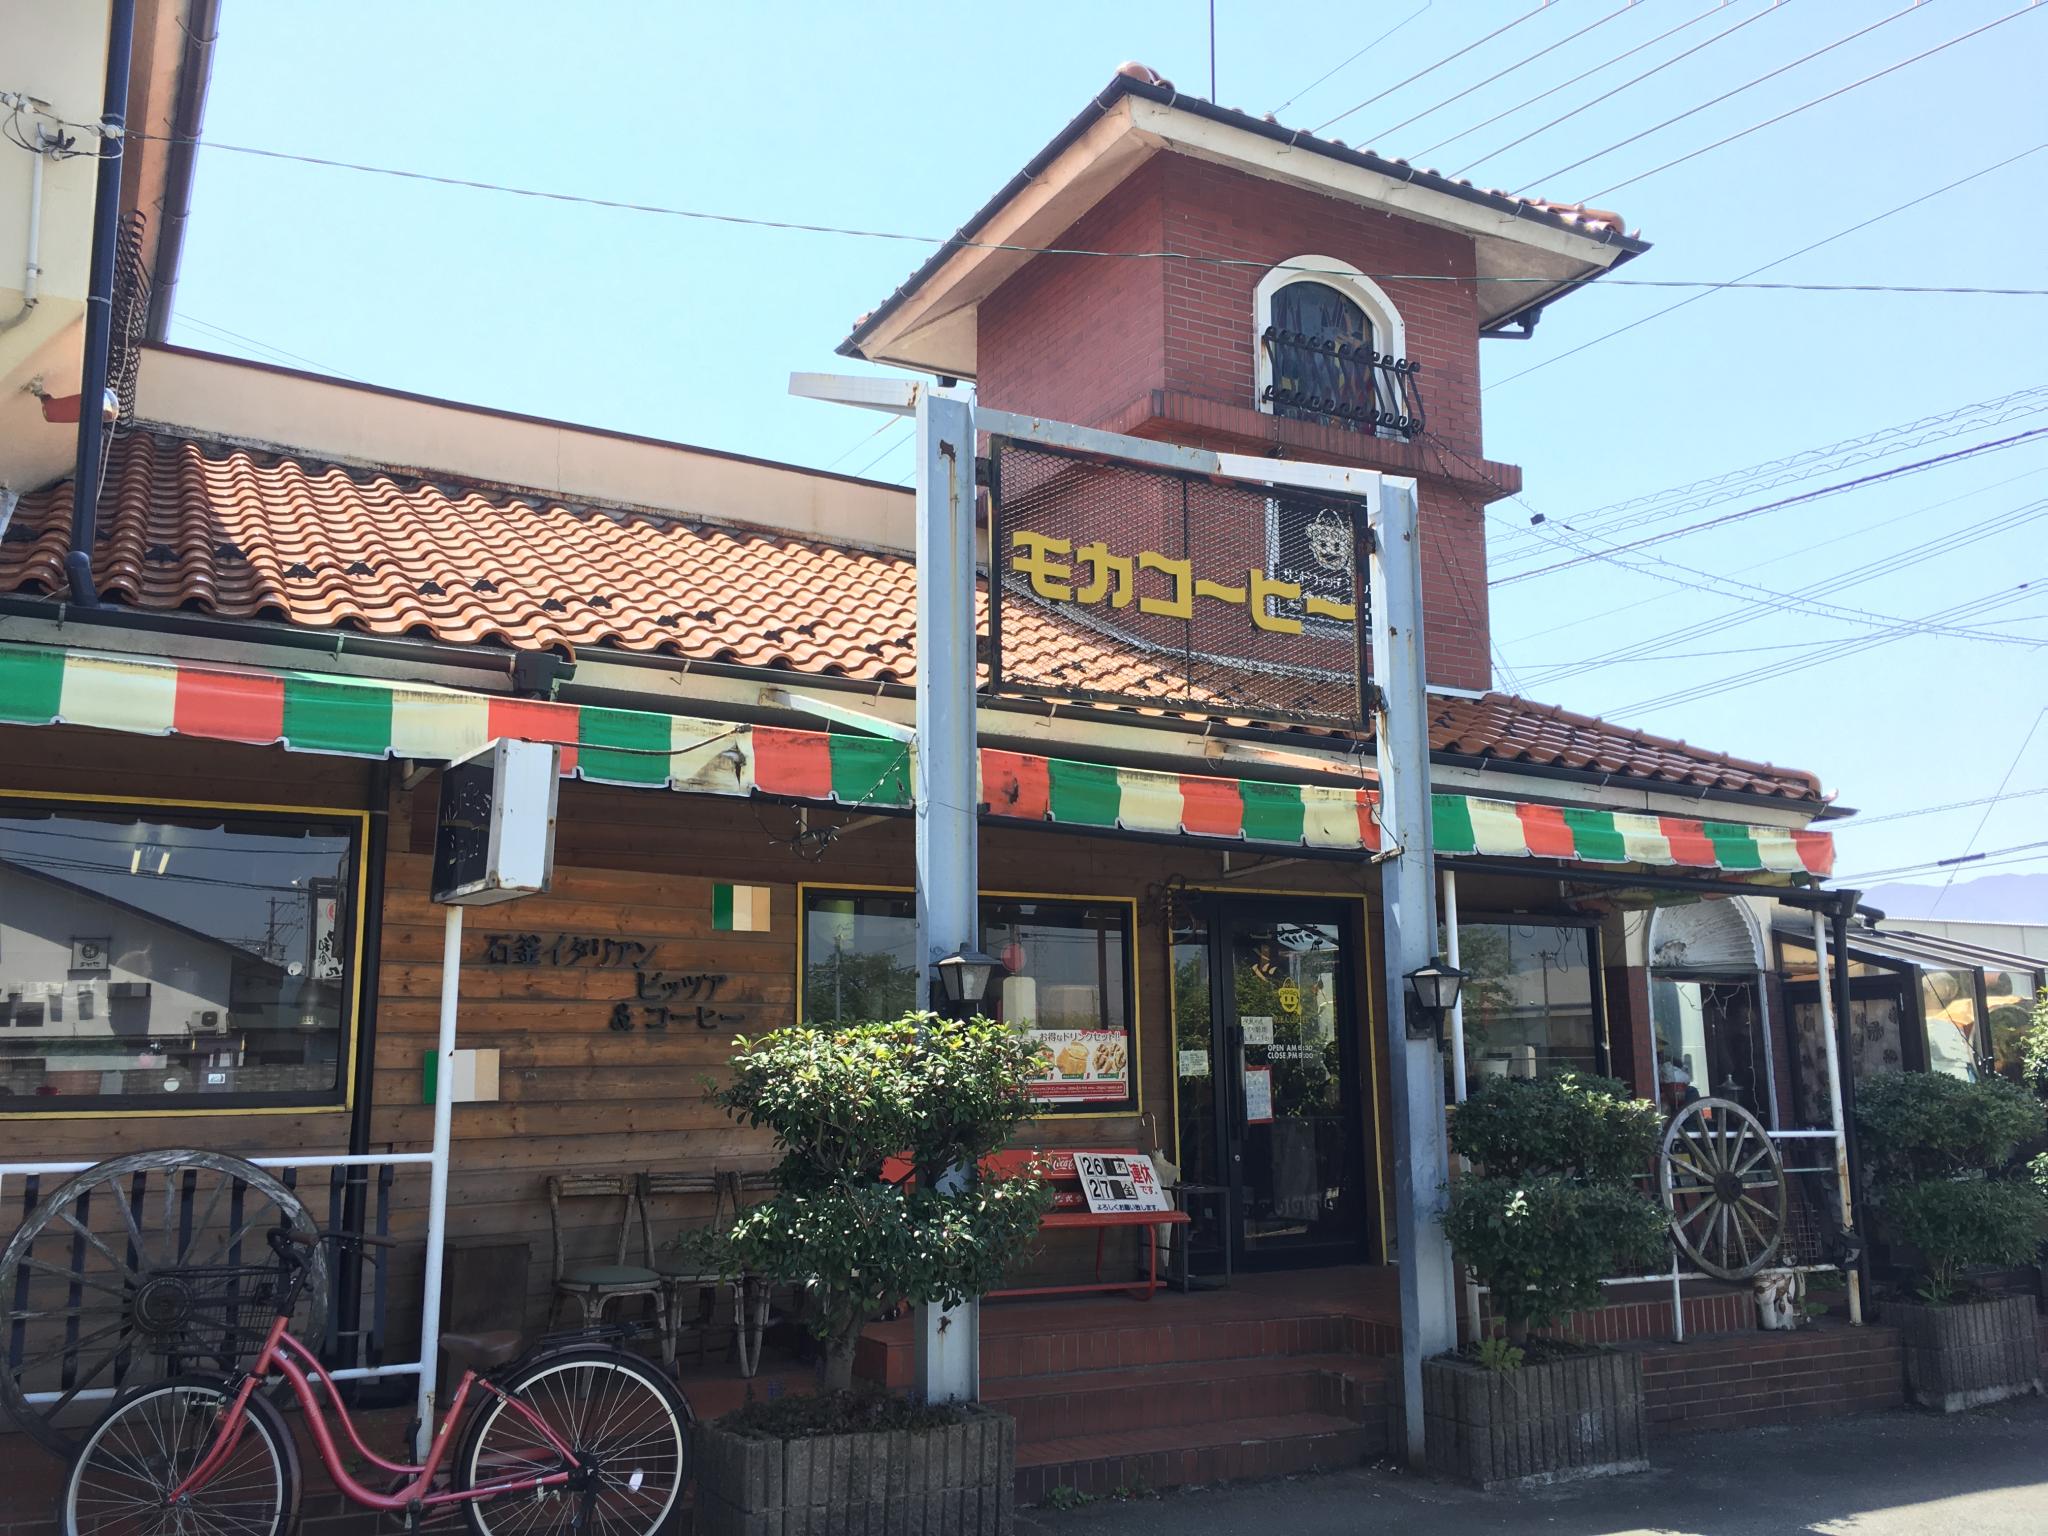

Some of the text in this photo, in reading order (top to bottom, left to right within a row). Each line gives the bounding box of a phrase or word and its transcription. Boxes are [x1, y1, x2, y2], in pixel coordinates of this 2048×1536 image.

[1012, 530, 1356, 635] モカコーヒー
[484, 932, 658, 969] 石釜イタリアン
[609, 1003, 744, 1031] & コーヒー
[1267, 1051, 1286, 1059] CLOSE
[1082, 1157, 1126, 1176] 26 木
[1128, 1163, 1154, 1184] 連休
[1089, 1179, 1135, 1199] 27 金
